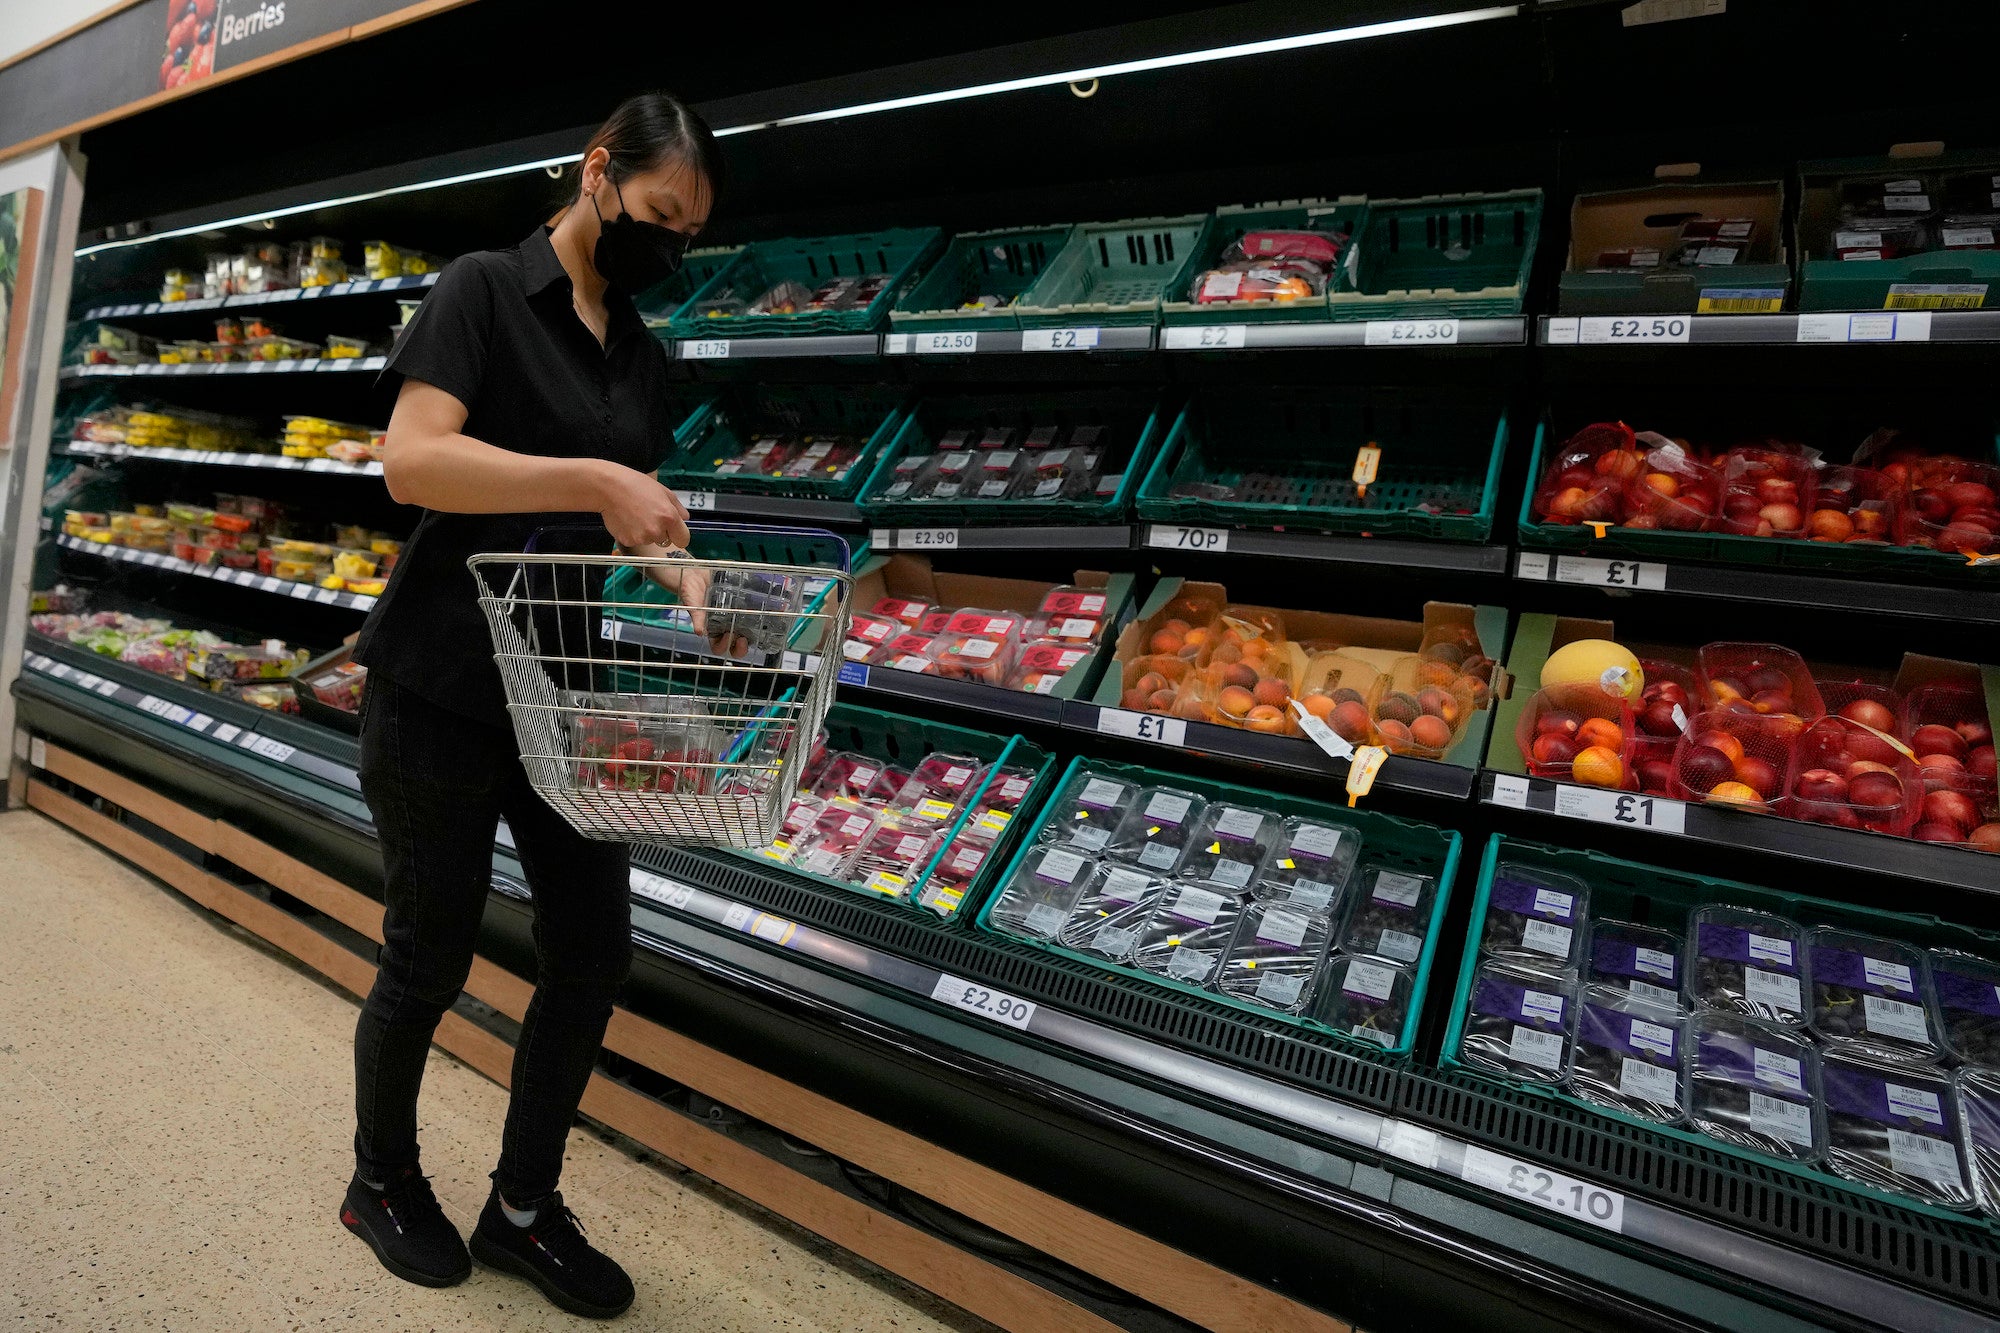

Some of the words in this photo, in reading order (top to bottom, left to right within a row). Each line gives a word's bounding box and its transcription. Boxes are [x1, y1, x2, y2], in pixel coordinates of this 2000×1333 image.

[220, 1, 286, 46] Berries
[1200, 327, 1228, 345] £2
[1391, 323, 1454, 339] £2.30
[1611, 319, 1685, 338] £2.50
[696, 342, 727, 356] £1.75
[932, 335, 974, 349] £2.50
[1051, 331, 1076, 348] £2
[689, 493, 705, 508] £3
[914, 531, 955, 545] £2.90
[1177, 528, 1219, 549] 70p
[1606, 560, 1641, 586] £1
[1137, 715, 1165, 740] £1
[1614, 794, 1654, 826] £1
[640, 876, 691, 904] £1.75
[730, 909, 745, 922] £2
[961, 987, 1028, 1021] £2.90
[1506, 1164, 1614, 1221] £2.10
